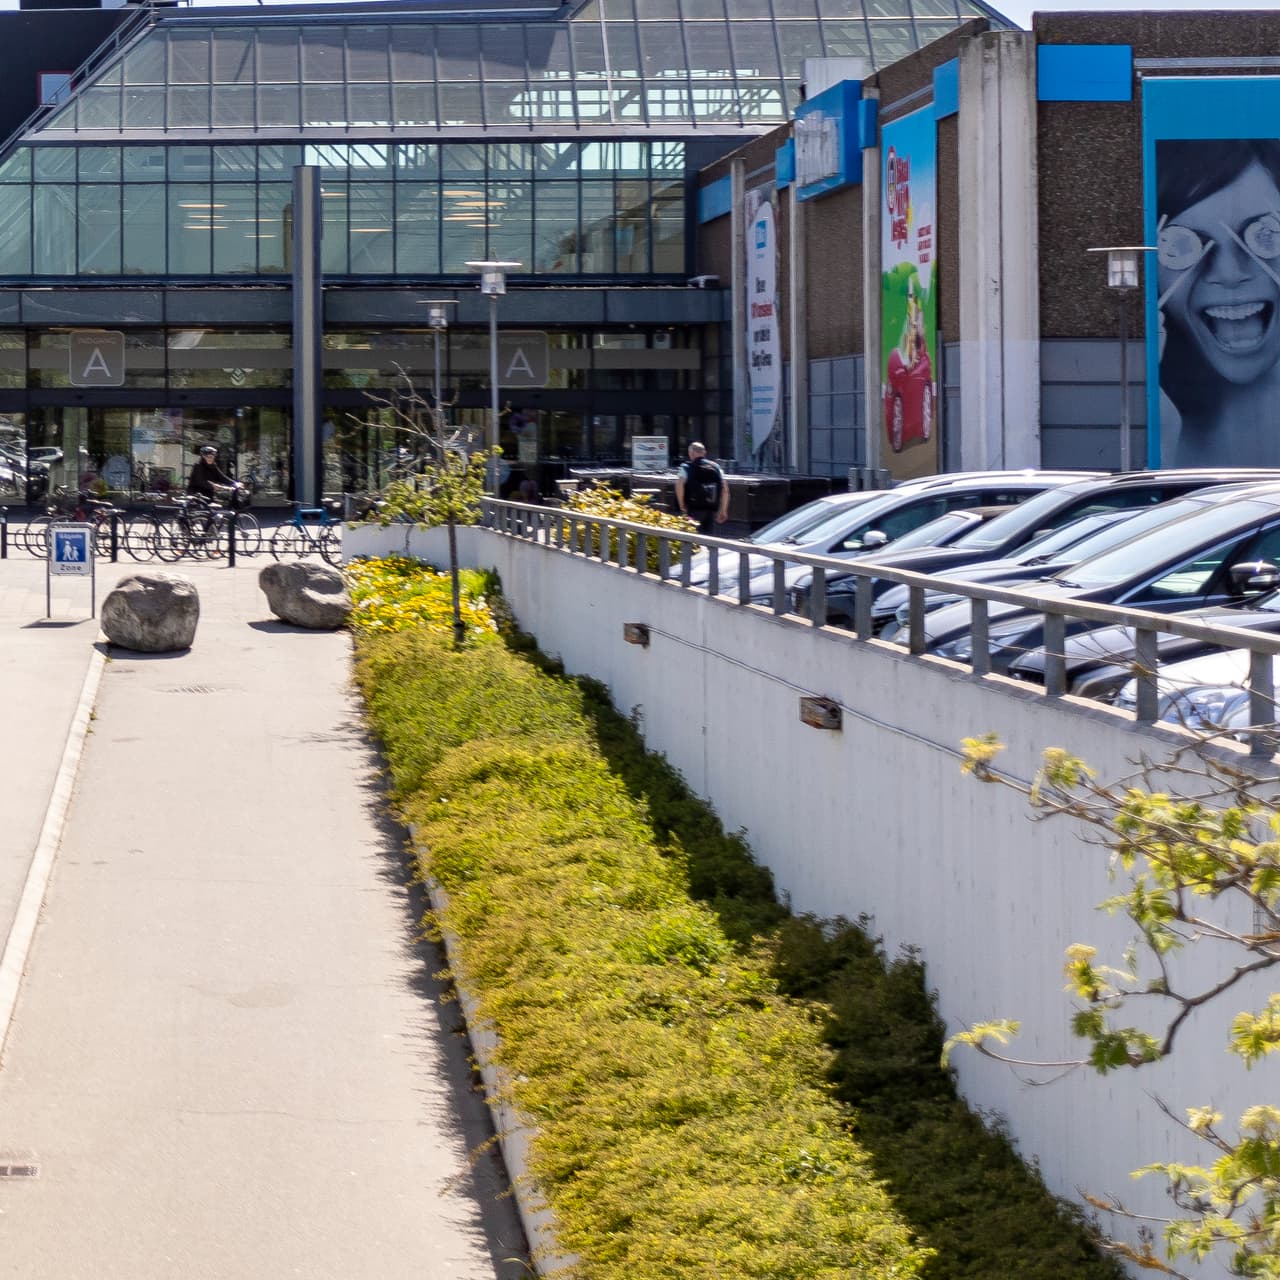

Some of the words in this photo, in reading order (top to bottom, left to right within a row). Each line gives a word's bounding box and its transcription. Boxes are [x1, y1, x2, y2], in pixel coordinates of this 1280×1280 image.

[83, 347, 112, 377] A
[505, 347, 536, 378] A
[60, 563, 82, 571] Zone
